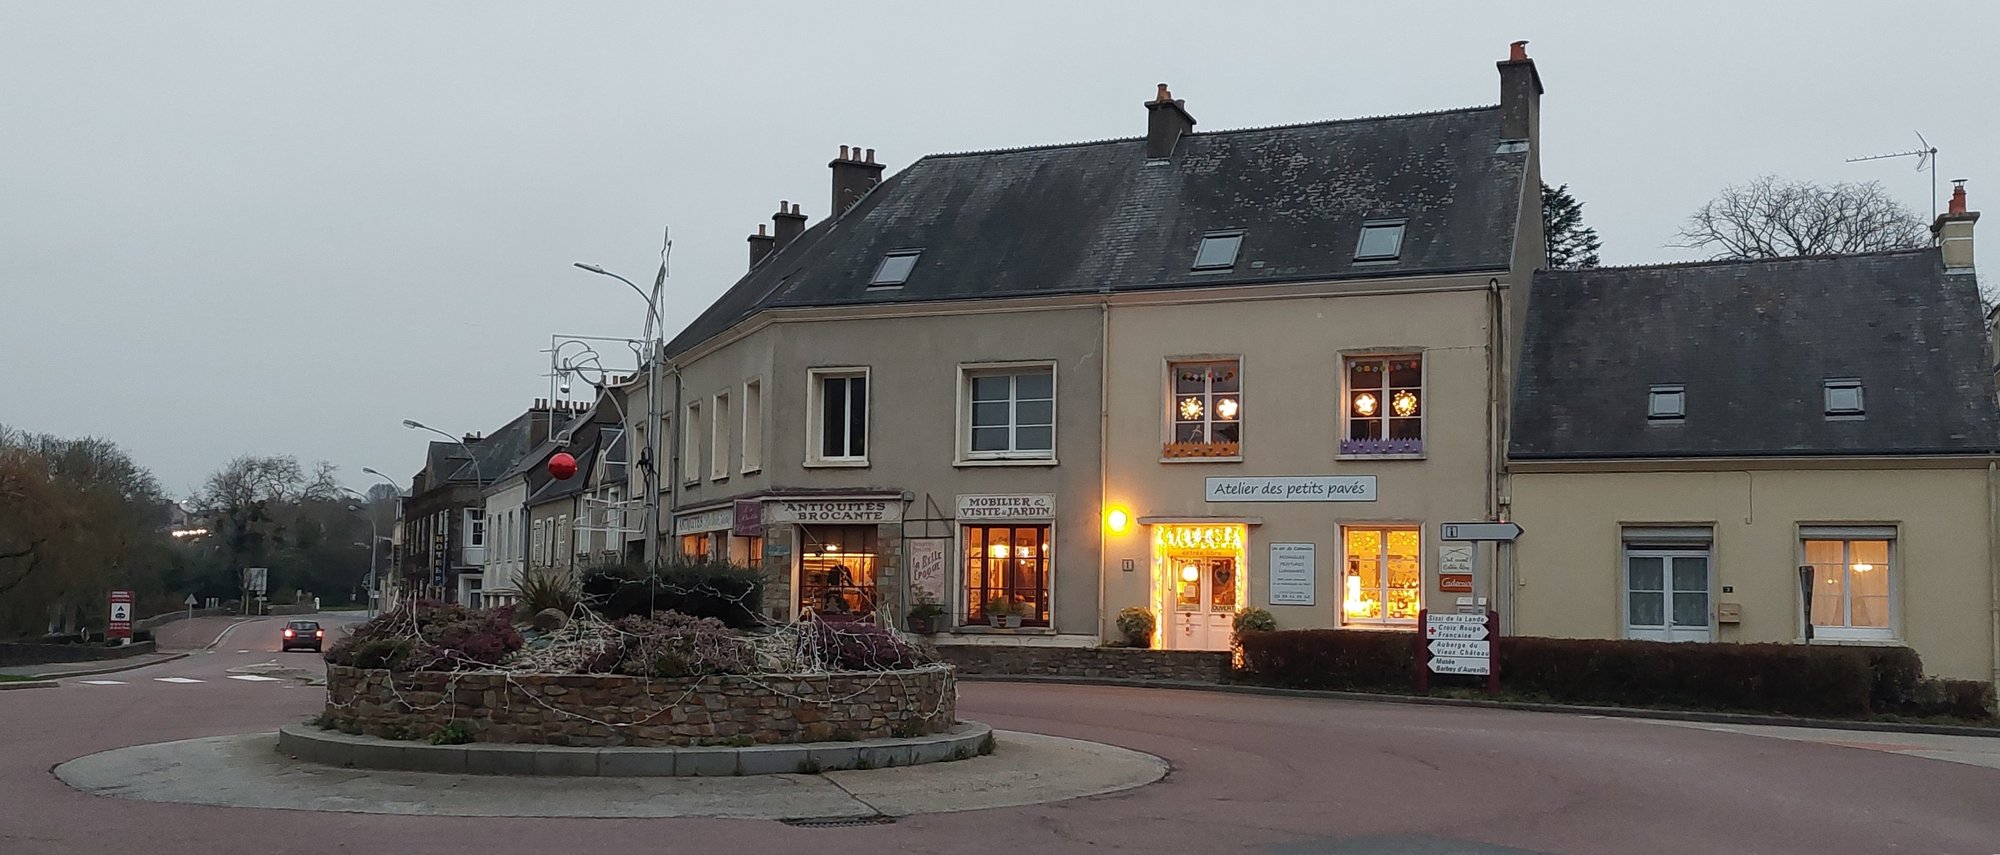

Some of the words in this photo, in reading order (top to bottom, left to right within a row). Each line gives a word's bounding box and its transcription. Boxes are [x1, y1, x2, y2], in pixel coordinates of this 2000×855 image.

[1214, 482, 1258, 495] Atelier
[1261, 482, 1283, 495] des
[1286, 482, 1324, 499] petits
[1327, 481, 1365, 498] pavés
[969, 497, 1031, 507] MOBILIER
[797, 511, 883, 521] BROCANTE
[961, 507, 1001, 516] VISITE
[1007, 506, 1050, 517] JARDIN
[1436, 641, 1466, 649] Auberge
